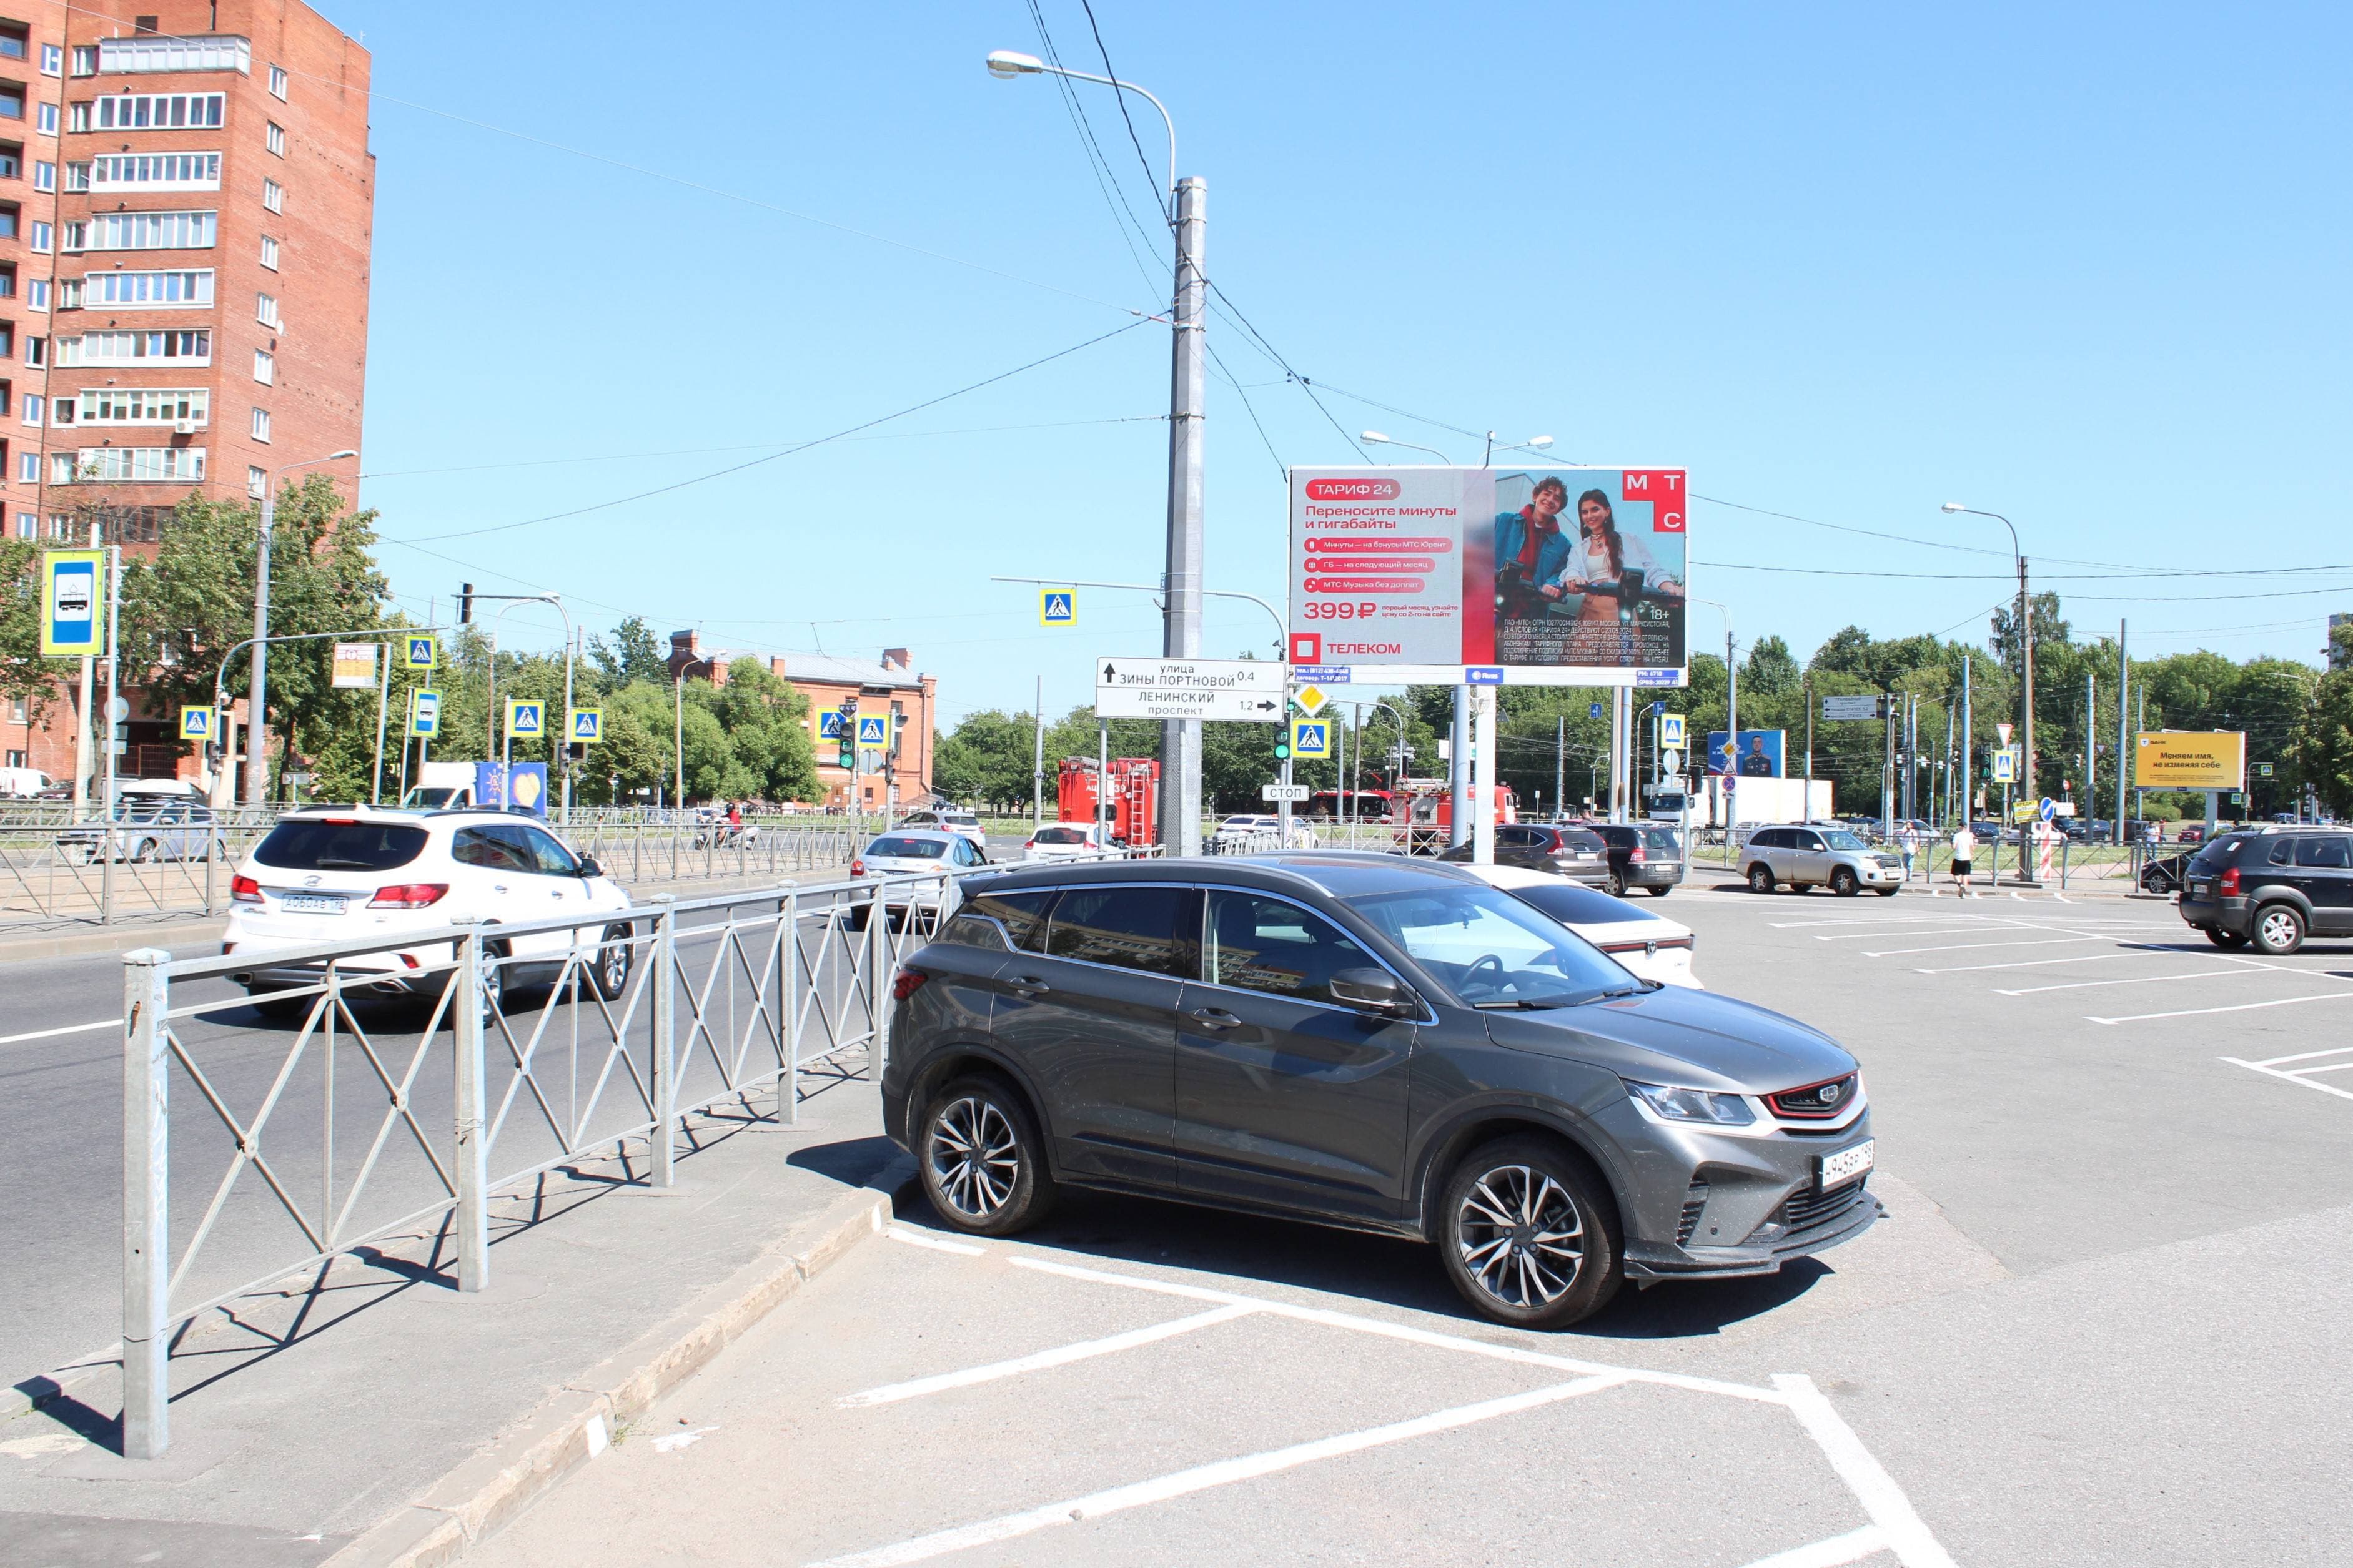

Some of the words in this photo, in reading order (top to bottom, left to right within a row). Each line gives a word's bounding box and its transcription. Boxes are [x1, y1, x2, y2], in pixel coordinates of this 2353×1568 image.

[1315, 484, 1370, 495] ТАРИФ
[1373, 484, 1393, 495] 24
[1305, 505, 1395, 518] Переносите
[1399, 508, 1457, 518] минуты
[1305, 521, 1314, 529] и
[1317, 518, 1396, 530] гигабайты
[1324, 541, 1354, 550] Минуты
[1373, 541, 1402, 550] бонусы
[1420, 541, 1446, 550] Юрент
[1355, 561, 1402, 570] следующий
[1650, 609, 1670, 620] 18+
[1327, 643, 1401, 654] ТЕЛЕКОМ
[1160, 665, 1194, 674] улица
[1119, 674, 1154, 684] ЗИНЫ
[1159, 674, 1234, 686] ПОРТНОВОЙ
[1139, 691, 1214, 703] ЛЕНИНСКИЙ
[1147, 706, 1203, 716] проспект
[1269, 788, 1302, 799] СТОП
